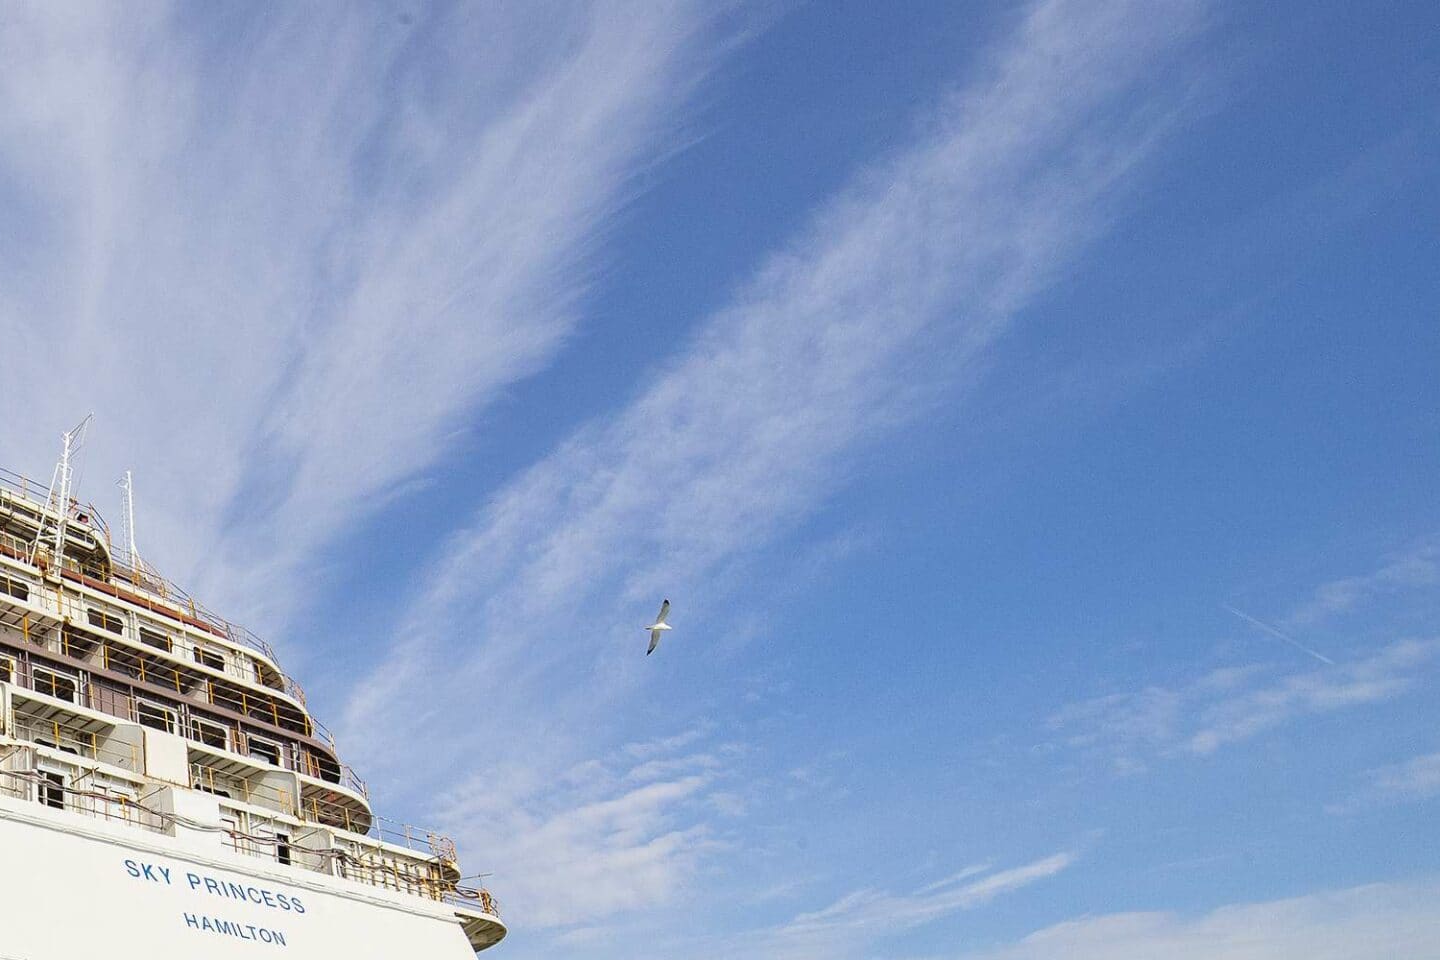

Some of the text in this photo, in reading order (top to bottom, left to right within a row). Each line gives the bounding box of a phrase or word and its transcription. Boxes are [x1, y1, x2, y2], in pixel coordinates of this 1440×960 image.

[124, 859, 306, 914] SKY PRINCESS
[183, 912, 287, 947] HAMILTON
